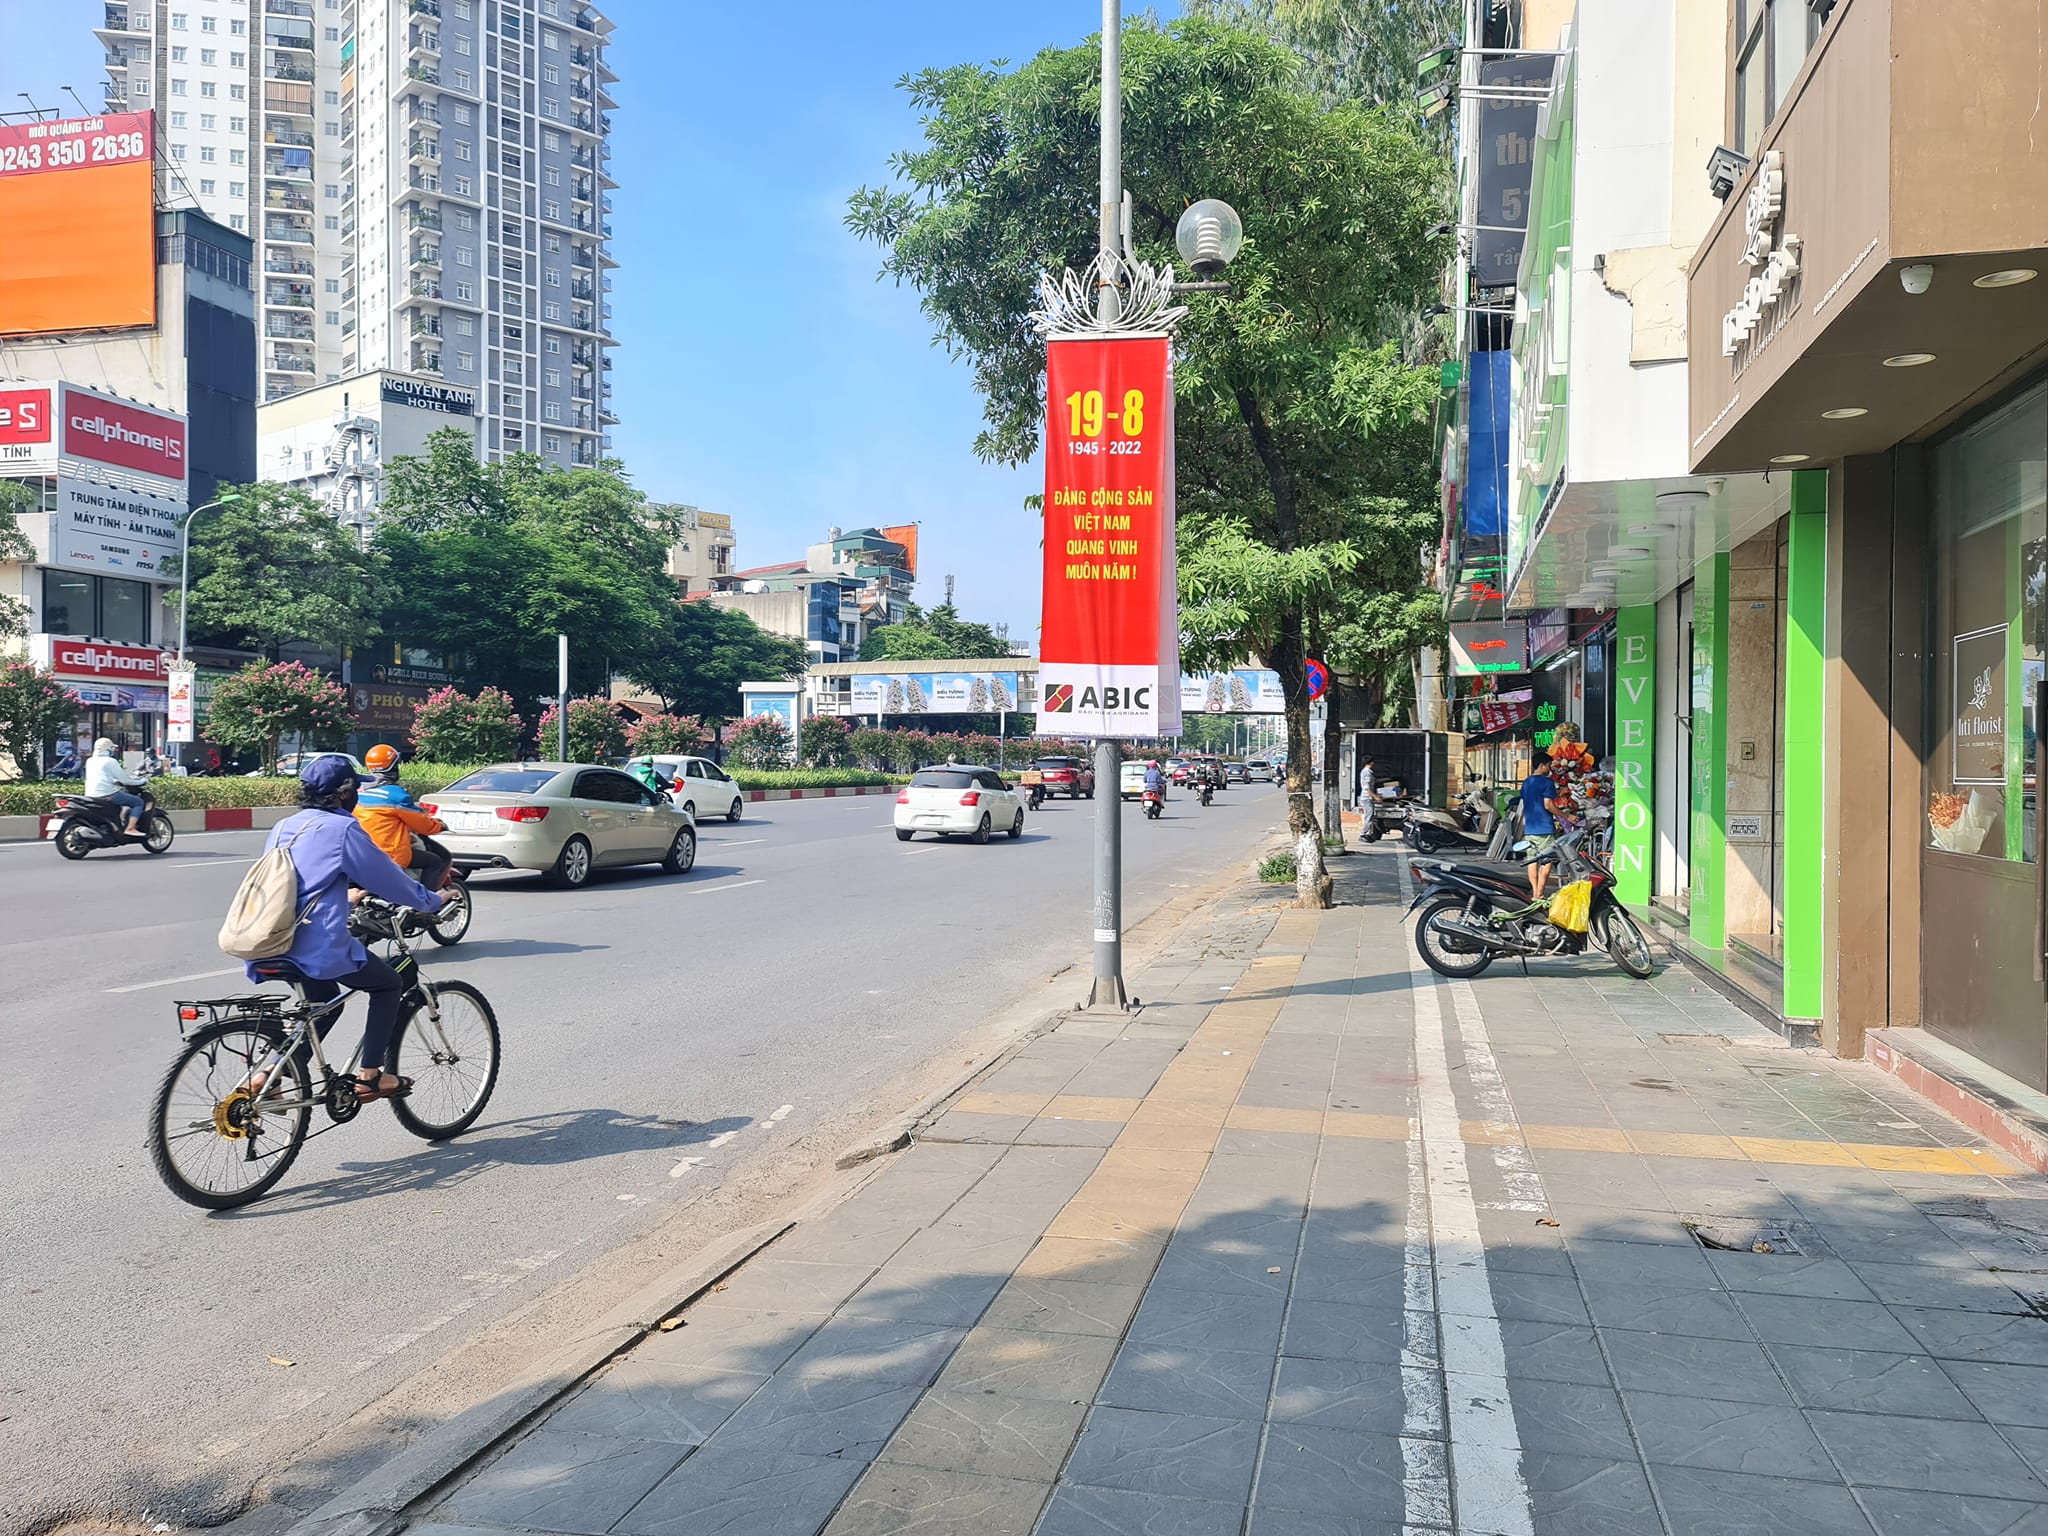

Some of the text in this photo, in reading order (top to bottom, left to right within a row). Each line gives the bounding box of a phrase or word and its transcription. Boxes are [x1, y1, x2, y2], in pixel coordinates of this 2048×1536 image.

[47, 139, 86, 167] 350
[91, 132, 144, 162] 2636
[408, 397, 450, 413] HOTEL
[445, 390, 474, 405] ANH
[1066, 389, 1144, 437] 19-8
[3, 445, 32, 458] TÍNH
[1069, 441, 1099, 456] 1945
[1109, 440, 1141, 455] 2022
[70, 491, 105, 508] TRUNG
[106, 497, 127, 512] TÂM
[128, 502, 150, 518] ĐIỆN
[1054, 485, 1153, 508] ĐẢNG CỘNG SẢN
[74, 511, 96, 524] MÁY
[98, 514, 121, 530] TÍNH
[128, 522, 144, 534] ÂM
[145, 526, 176, 540] THANH
[1074, 512, 1131, 534] VIỆT NAM
[70, 550, 96, 561] Lenovo
[100, 544, 130, 556] SAMSUNG
[1066, 539, 1138, 556] QUANG VINH
[1066, 560, 1100, 581] MUÔN
[1103, 560, 1130, 581] NĂM
[1079, 686, 1150, 710] ABIC
[1973, 716, 2003, 736] florist
[1618, 635, 1648, 872] EVERON
